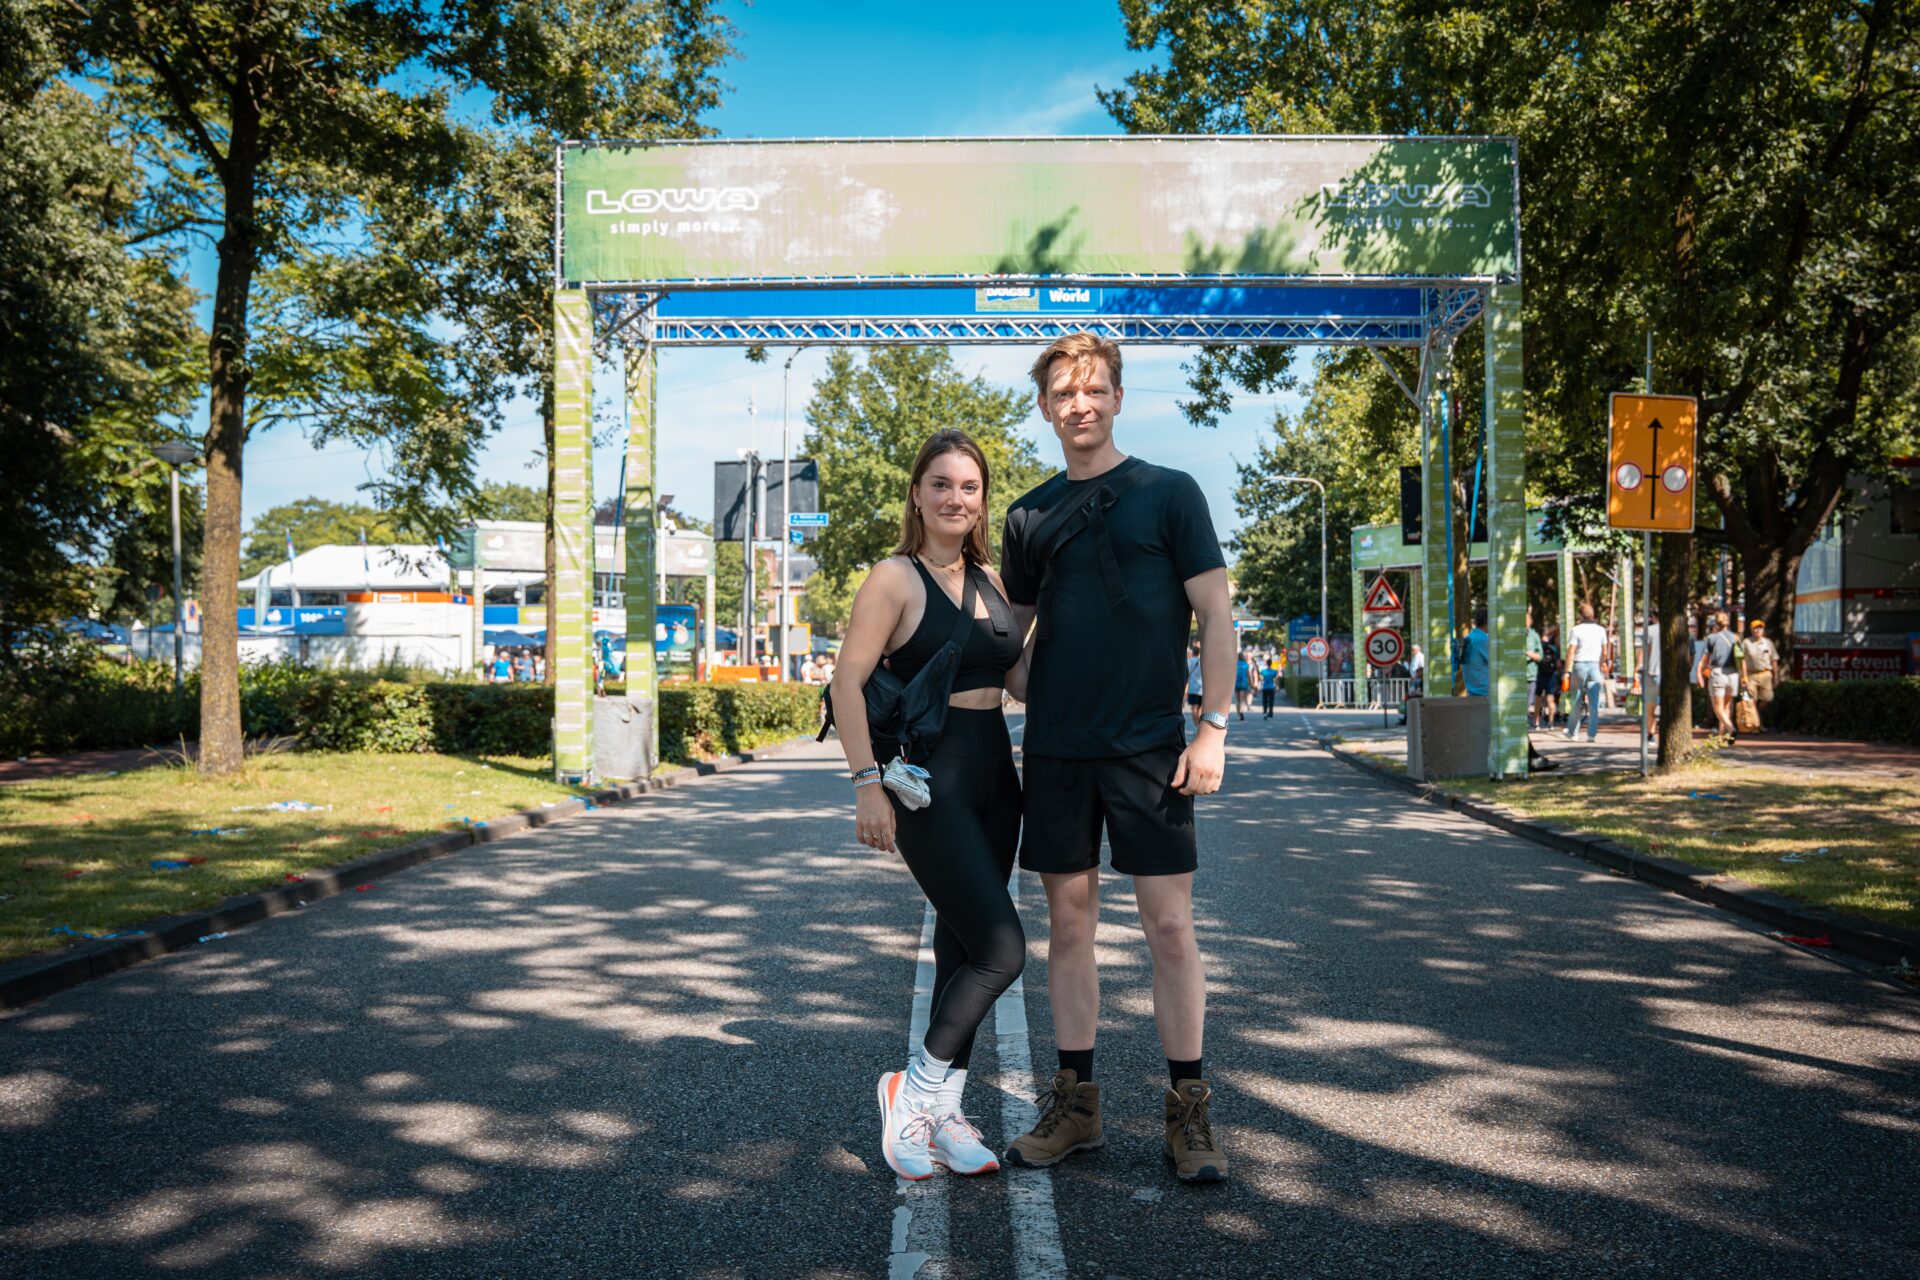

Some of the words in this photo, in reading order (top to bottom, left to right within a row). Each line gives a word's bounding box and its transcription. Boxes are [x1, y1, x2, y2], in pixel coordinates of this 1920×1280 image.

[586, 186, 759, 214] LOWA
[1320, 183, 1491, 208] LOWA
[610, 219, 669, 236] simply
[1344, 214, 1403, 231] simply
[1411, 216, 1476, 229] more...
[1049, 289, 1090, 303] World
[1372, 639, 1397, 655] 30
[1851, 655, 1902, 669] event
[1802, 669, 1834, 682] een
[1839, 669, 1901, 681] succes
